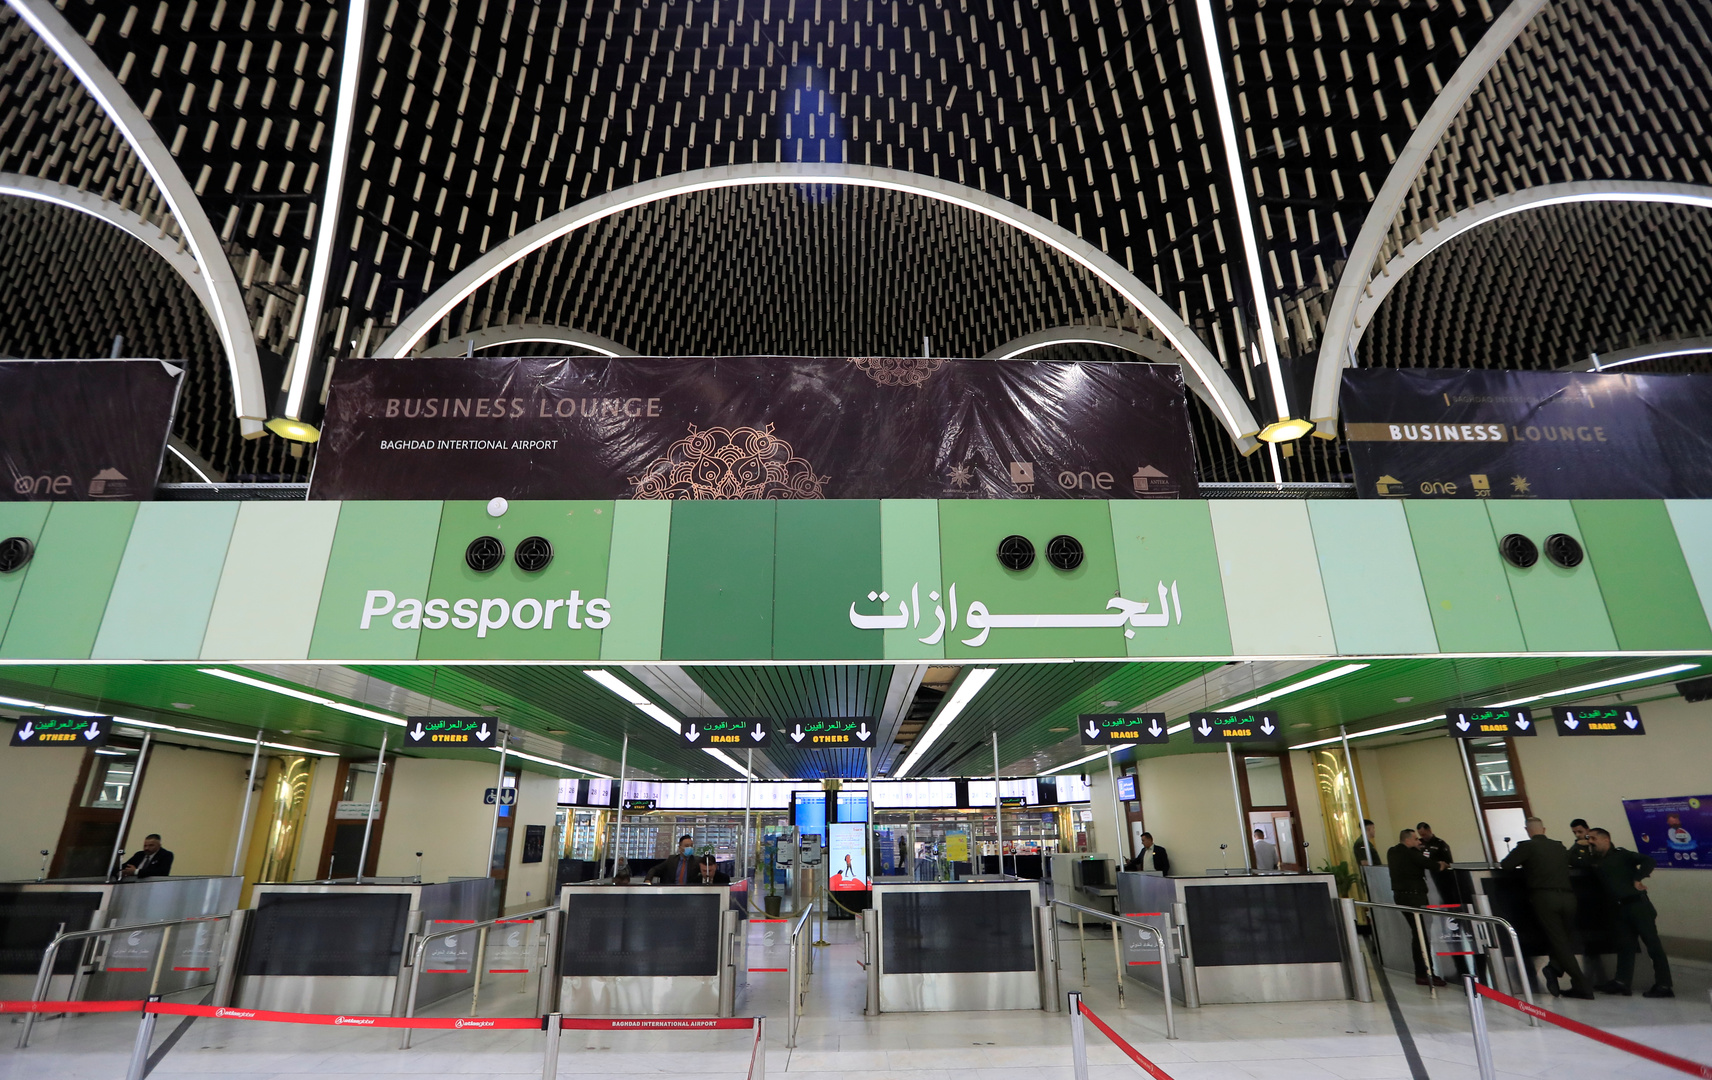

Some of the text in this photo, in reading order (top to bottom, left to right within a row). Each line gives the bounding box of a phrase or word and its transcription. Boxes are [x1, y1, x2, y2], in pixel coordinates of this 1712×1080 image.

[384, 397, 661, 418] BUSINESS LOUNGE
[1389, 425, 1607, 442] BUSINESS LOUNGE
[380, 440, 558, 450] BAGHDAD INTERTIONAL AIRPORT
[360, 590, 611, 638] Passports
[849, 580, 1182, 647] الجوازات
[1470, 710, 1511, 721] العراقيون
[1578, 709, 1619, 720] العراقيون
[35, 719, 88, 730] غير العراقيين
[425, 720, 478, 731] غير العراقيين
[703, 721, 747, 731] العراقيون
[804, 720, 857, 732] غير العراقيين
[1101, 716, 1144, 728] العراقيون
[1213, 715, 1256, 726] العراقيون
[1588, 722, 1617, 730] IRAQIS
[1222, 728, 1252, 737] IRAQIS
[1480, 724, 1509, 732] IRAQIS
[39, 733, 77, 741] OTHERS
[432, 734, 469, 742] OTHERS
[710, 735, 741, 743] IRAQIS
[812, 734, 849, 743] OTHERS
[1110, 730, 1139, 738] IRAQIS
